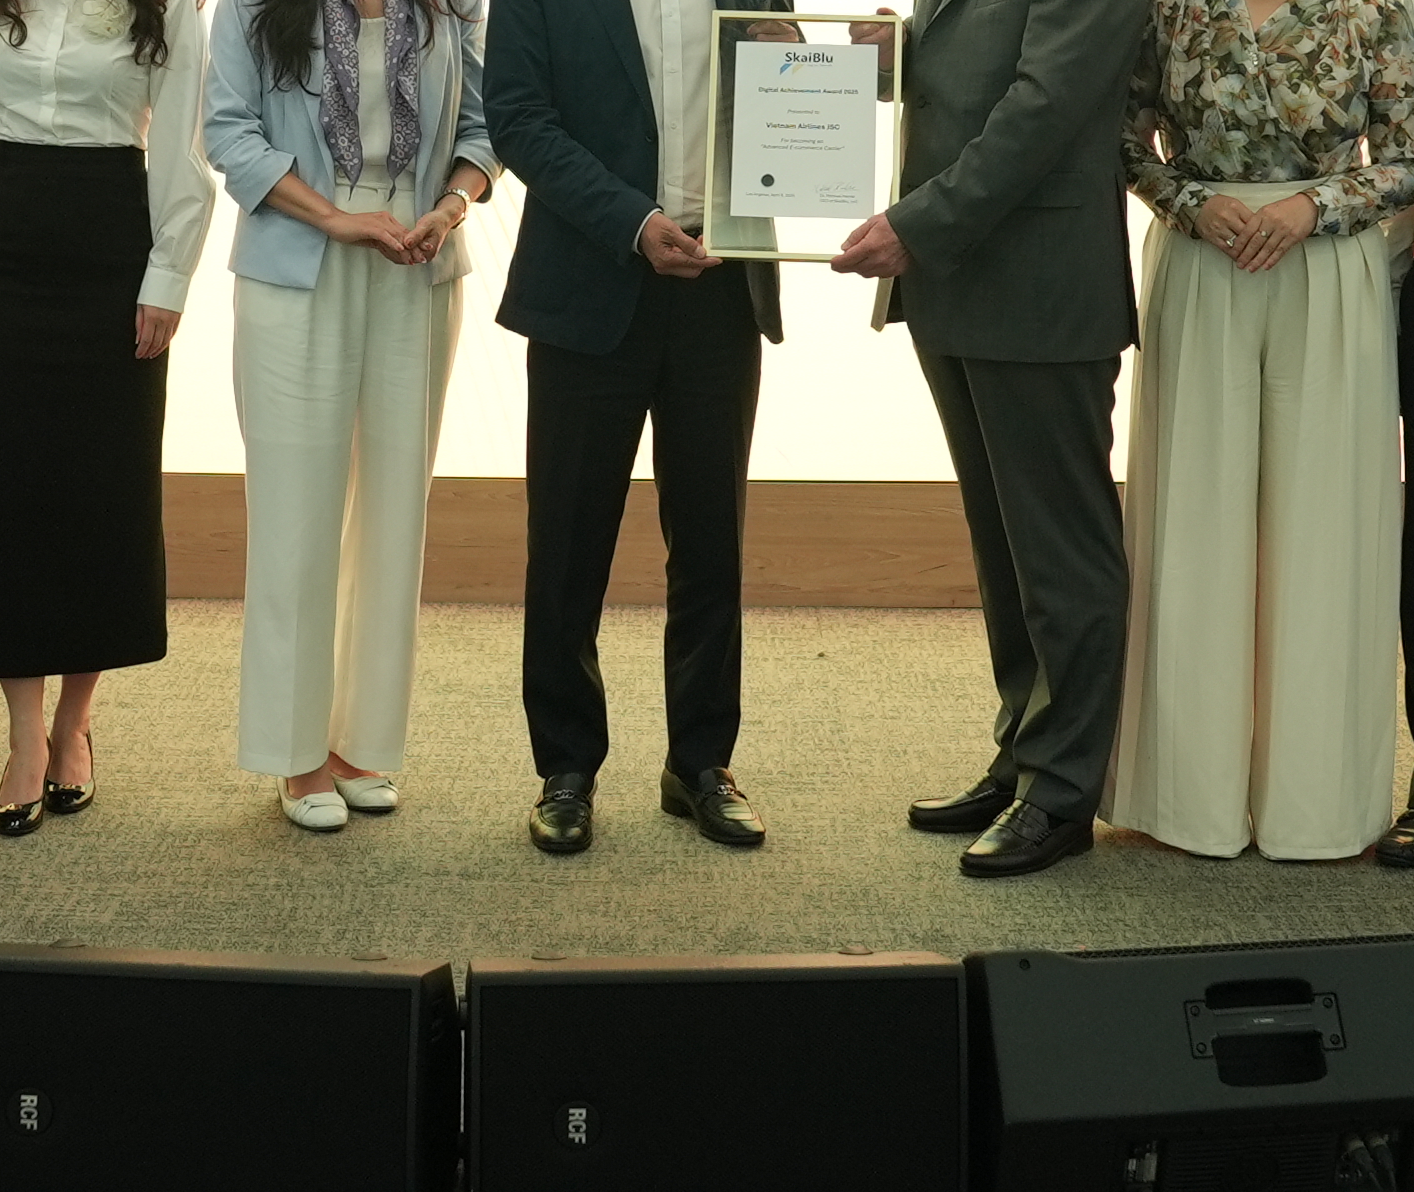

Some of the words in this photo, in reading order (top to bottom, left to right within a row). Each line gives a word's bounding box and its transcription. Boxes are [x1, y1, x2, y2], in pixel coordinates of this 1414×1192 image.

[785, 52, 833, 63] SkaiBlu
[20, 1094, 38, 1130] RCF
[568, 1108, 587, 1144] RCF
